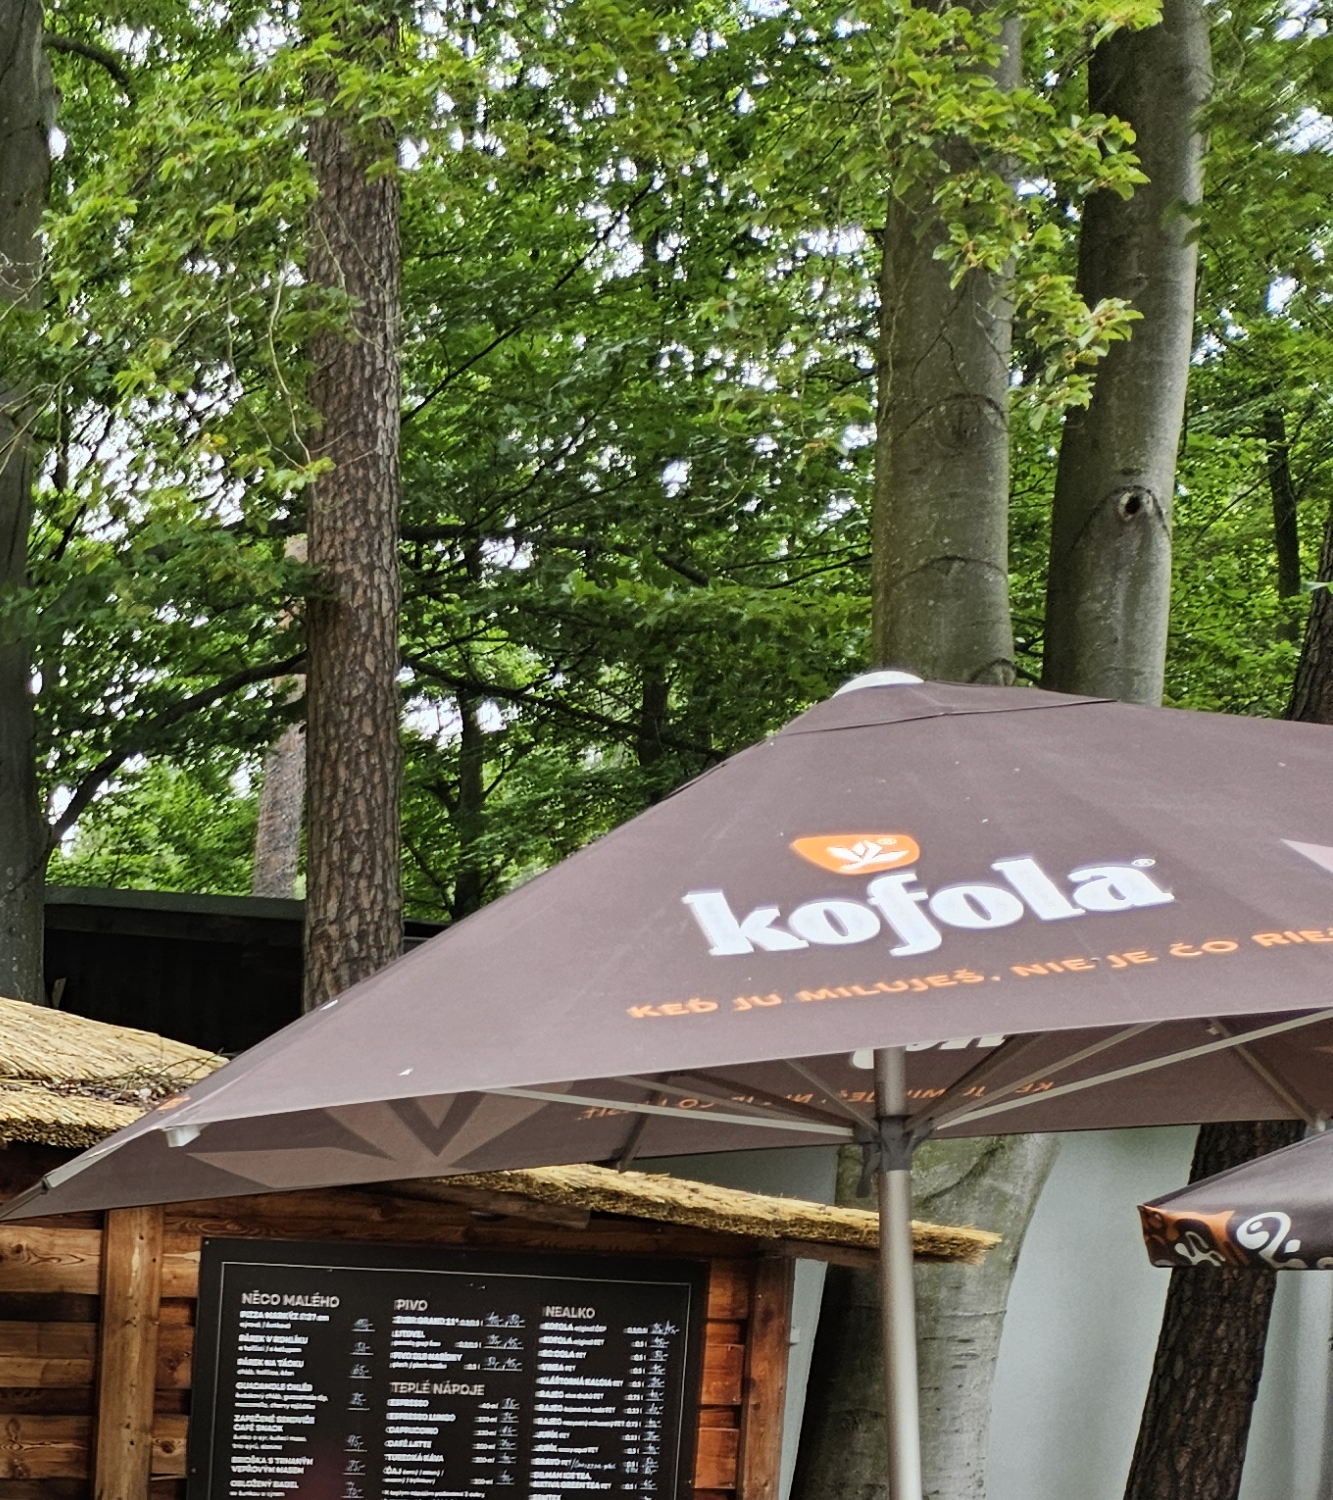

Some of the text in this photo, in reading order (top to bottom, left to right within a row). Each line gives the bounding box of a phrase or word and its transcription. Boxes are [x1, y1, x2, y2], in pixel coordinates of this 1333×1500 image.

[681, 855, 1175, 957] kofola
[626, 997, 718, 1018] KEĎ
[733, 993, 782, 1012] JU
[1009, 958, 1096, 977] NIE
[1106, 950, 1159, 969] JE
[1169, 940, 1239, 958] ČO
[1251, 927, 1333, 947] RIE
[283, 1292, 340, 1308] MALÉHO
[395, 1299, 428, 1311] PIVO
[545, 1306, 596, 1319] NEALKO
[391, 1379, 485, 1396] TEPLÉ NÁPOJE
